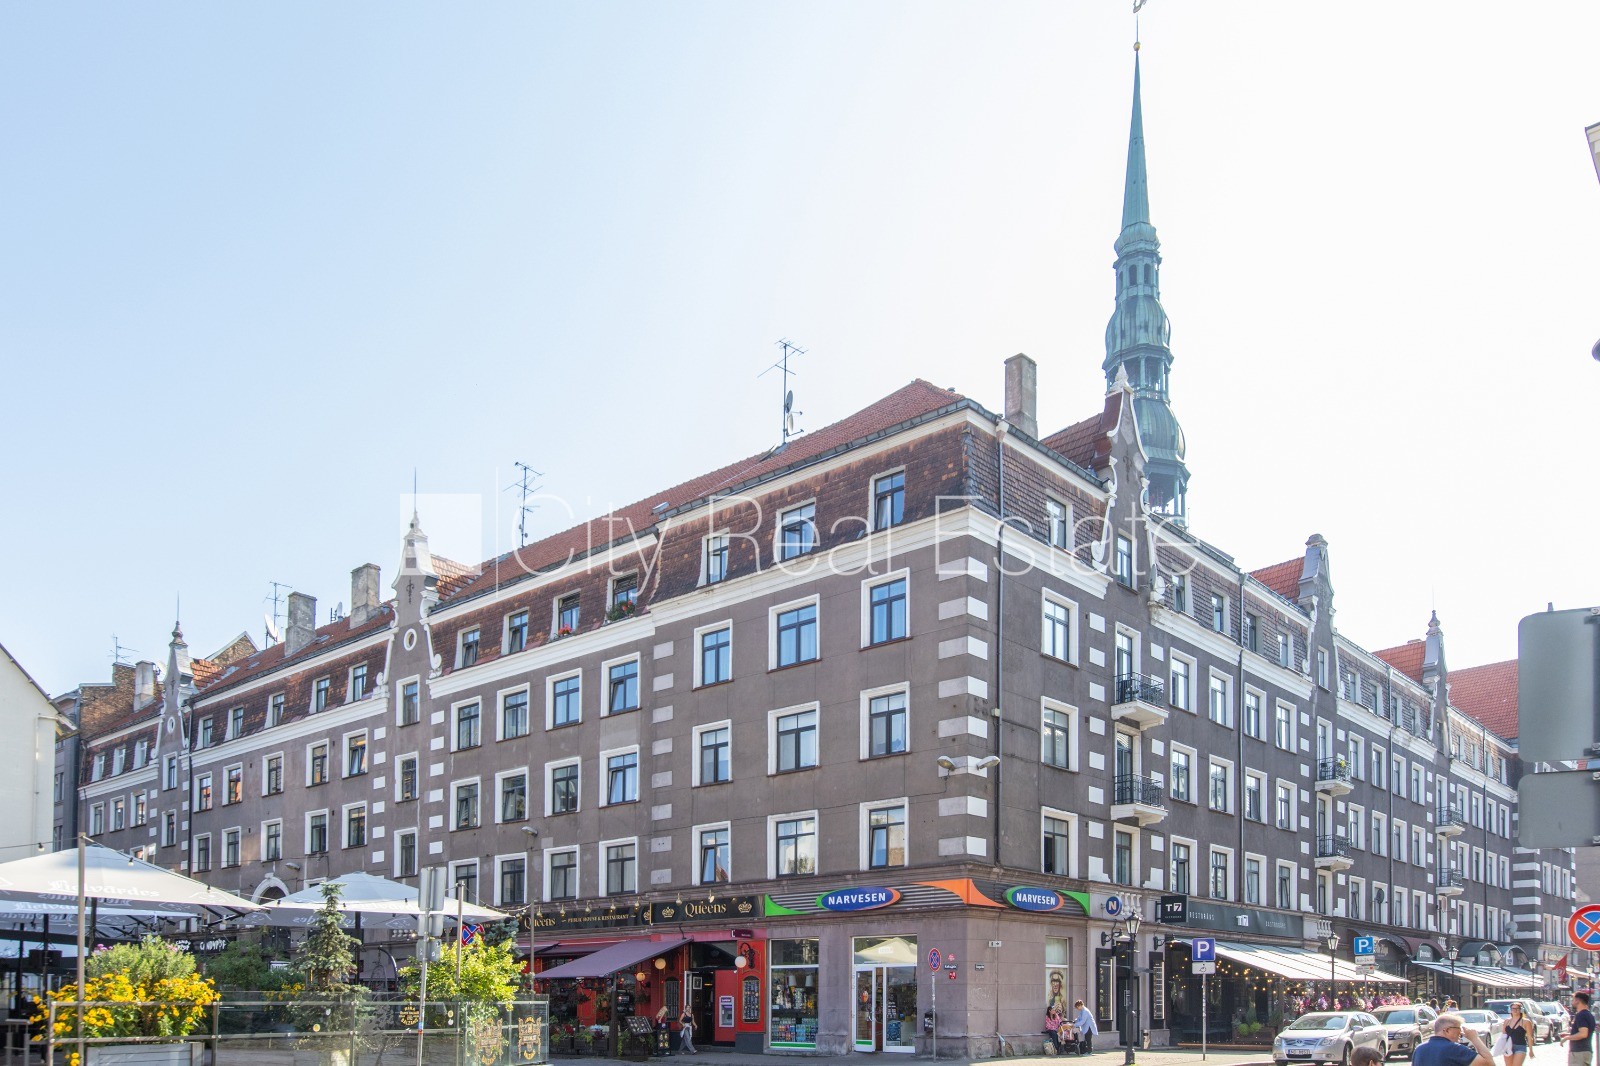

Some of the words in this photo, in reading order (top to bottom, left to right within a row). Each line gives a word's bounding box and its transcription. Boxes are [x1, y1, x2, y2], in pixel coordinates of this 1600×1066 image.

[828, 892, 886, 905] NARVESEN
[1016, 892, 1056, 906] NARVESEN
[685, 902, 727, 918] Queens
[1108, 901, 1117, 911] N
[1197, 941, 1210, 959] P
[1359, 939, 1369, 953] P
